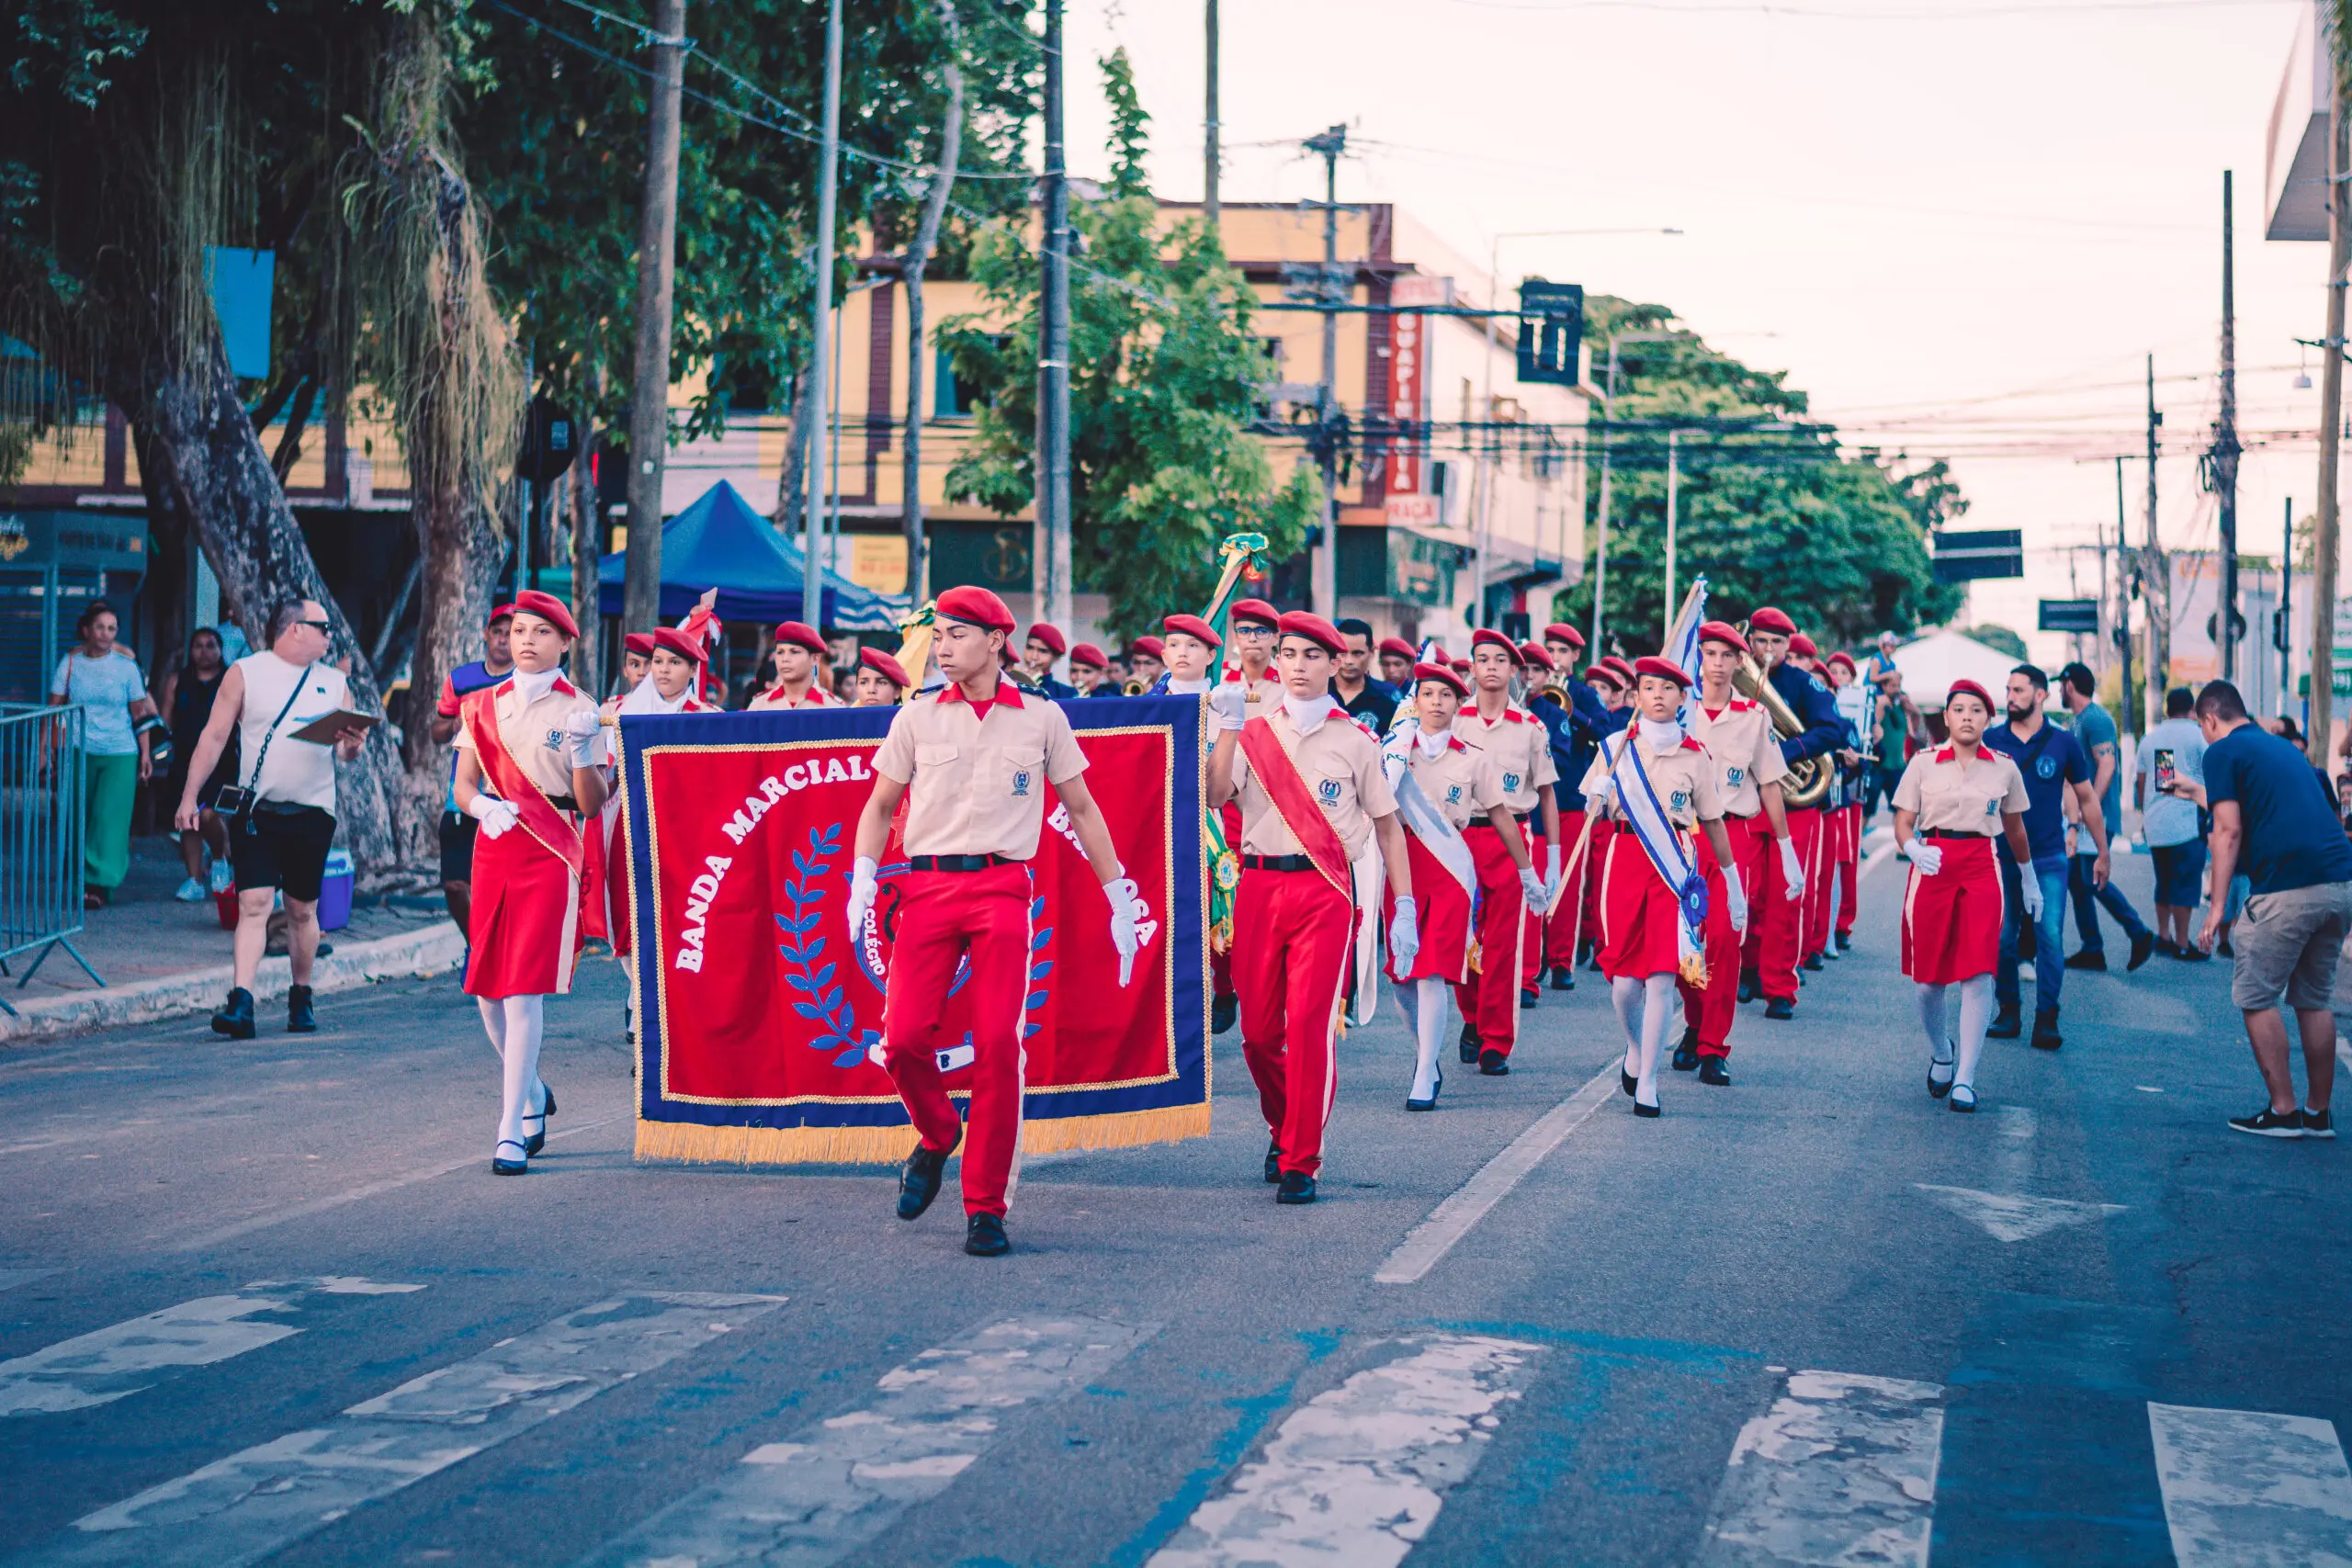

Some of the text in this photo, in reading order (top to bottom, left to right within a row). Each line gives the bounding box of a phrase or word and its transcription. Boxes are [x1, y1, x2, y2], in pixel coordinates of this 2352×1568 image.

[675, 755, 871, 973] BANDA MARCIAL
[864, 908, 886, 976] COLÉGIO
